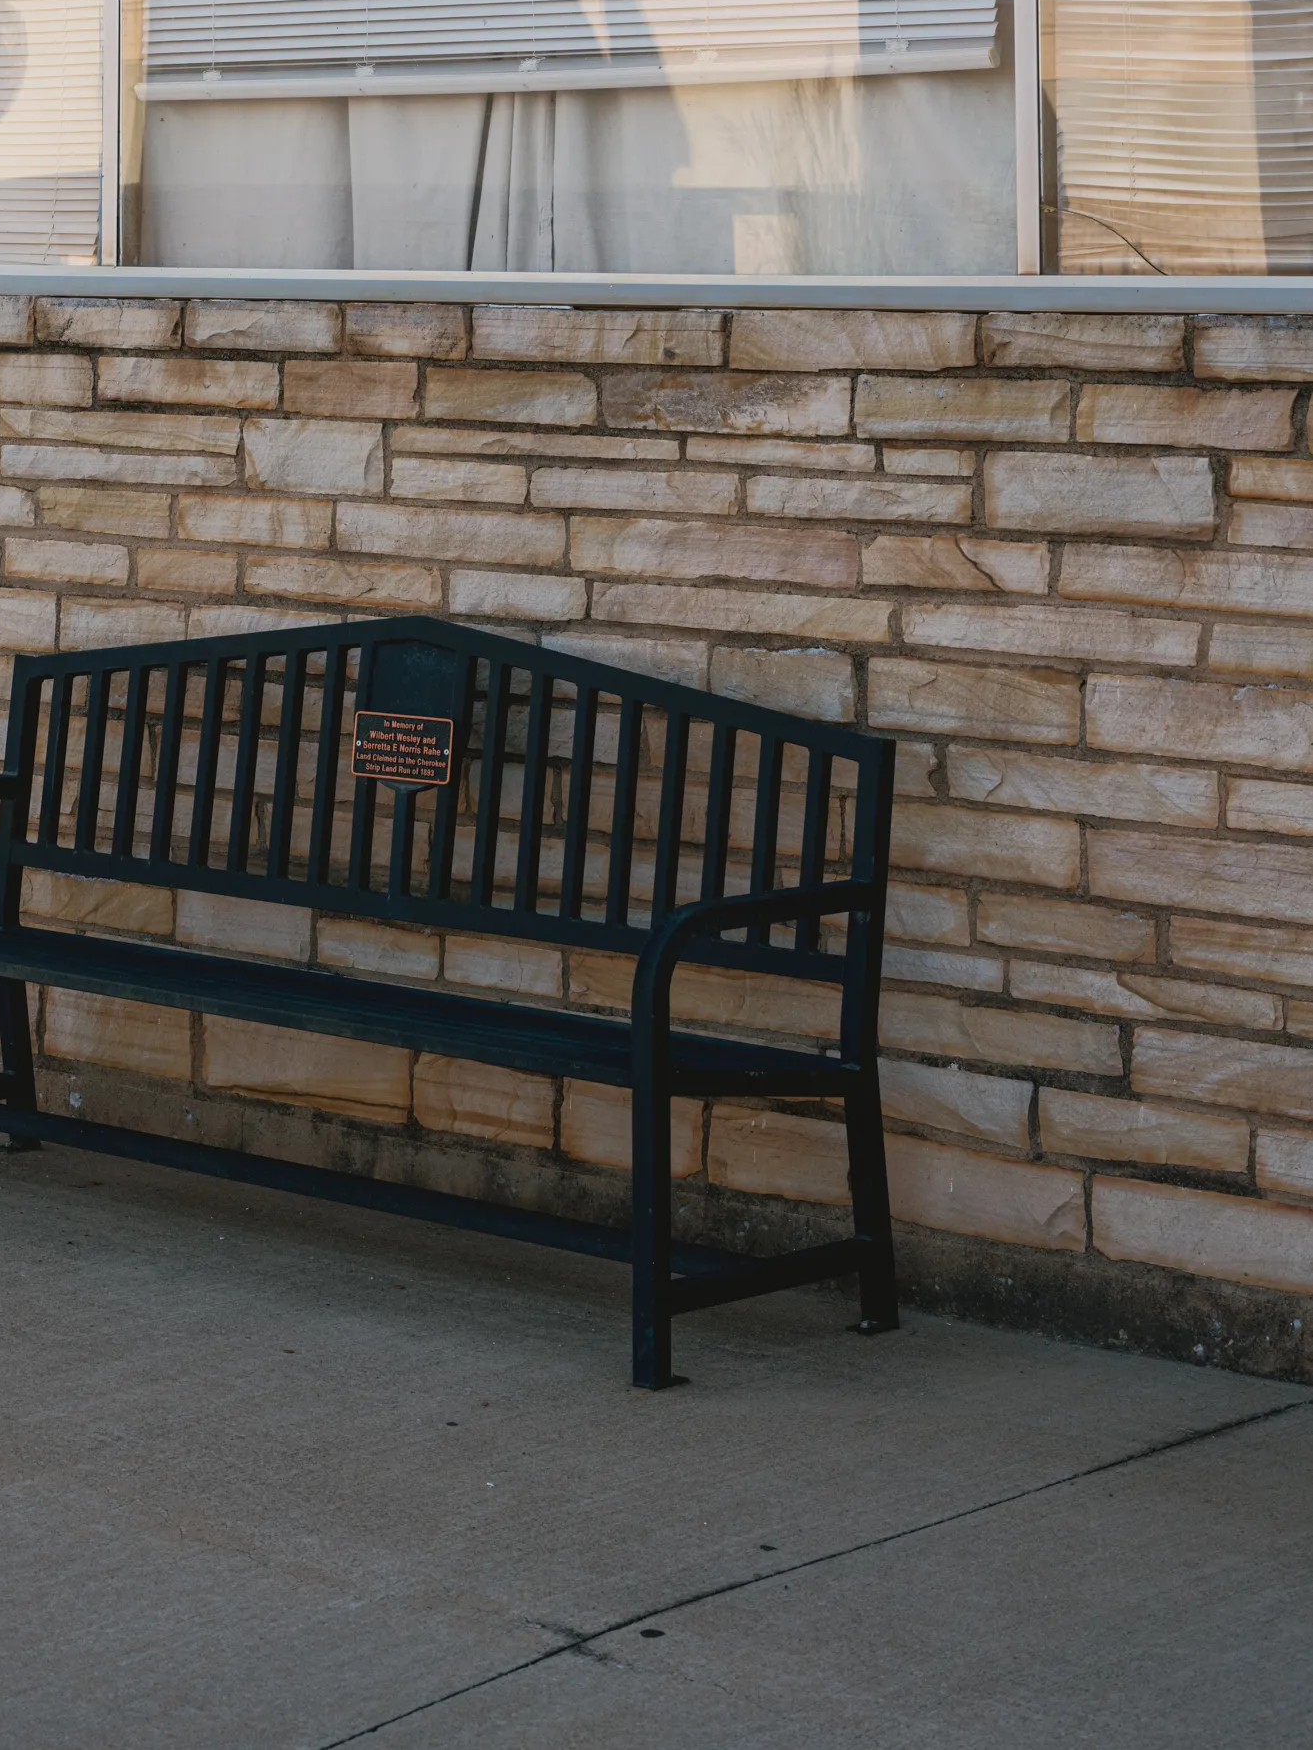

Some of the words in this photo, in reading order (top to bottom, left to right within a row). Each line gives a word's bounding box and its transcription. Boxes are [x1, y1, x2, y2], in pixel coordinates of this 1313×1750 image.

[383, 719, 390, 728] In
[392, 720, 416, 731] Memory
[370, 730, 395, 741] Wilbert
[396, 732, 421, 745] Wesley
[423, 737, 436, 745] and
[399, 744, 421, 754] Norris
[423, 746, 441, 756] Rahe
[356, 752, 371, 760] Land
[372, 753, 397, 763] Claimed
[398, 755, 404, 763] in
[406, 756, 416, 765] the
[417, 757, 446, 768] Cherokee
[365, 762, 381, 772] Strip
[382, 764, 397, 773] Land
[398, 766, 410, 775] Run
[411, 767, 419, 775] of
